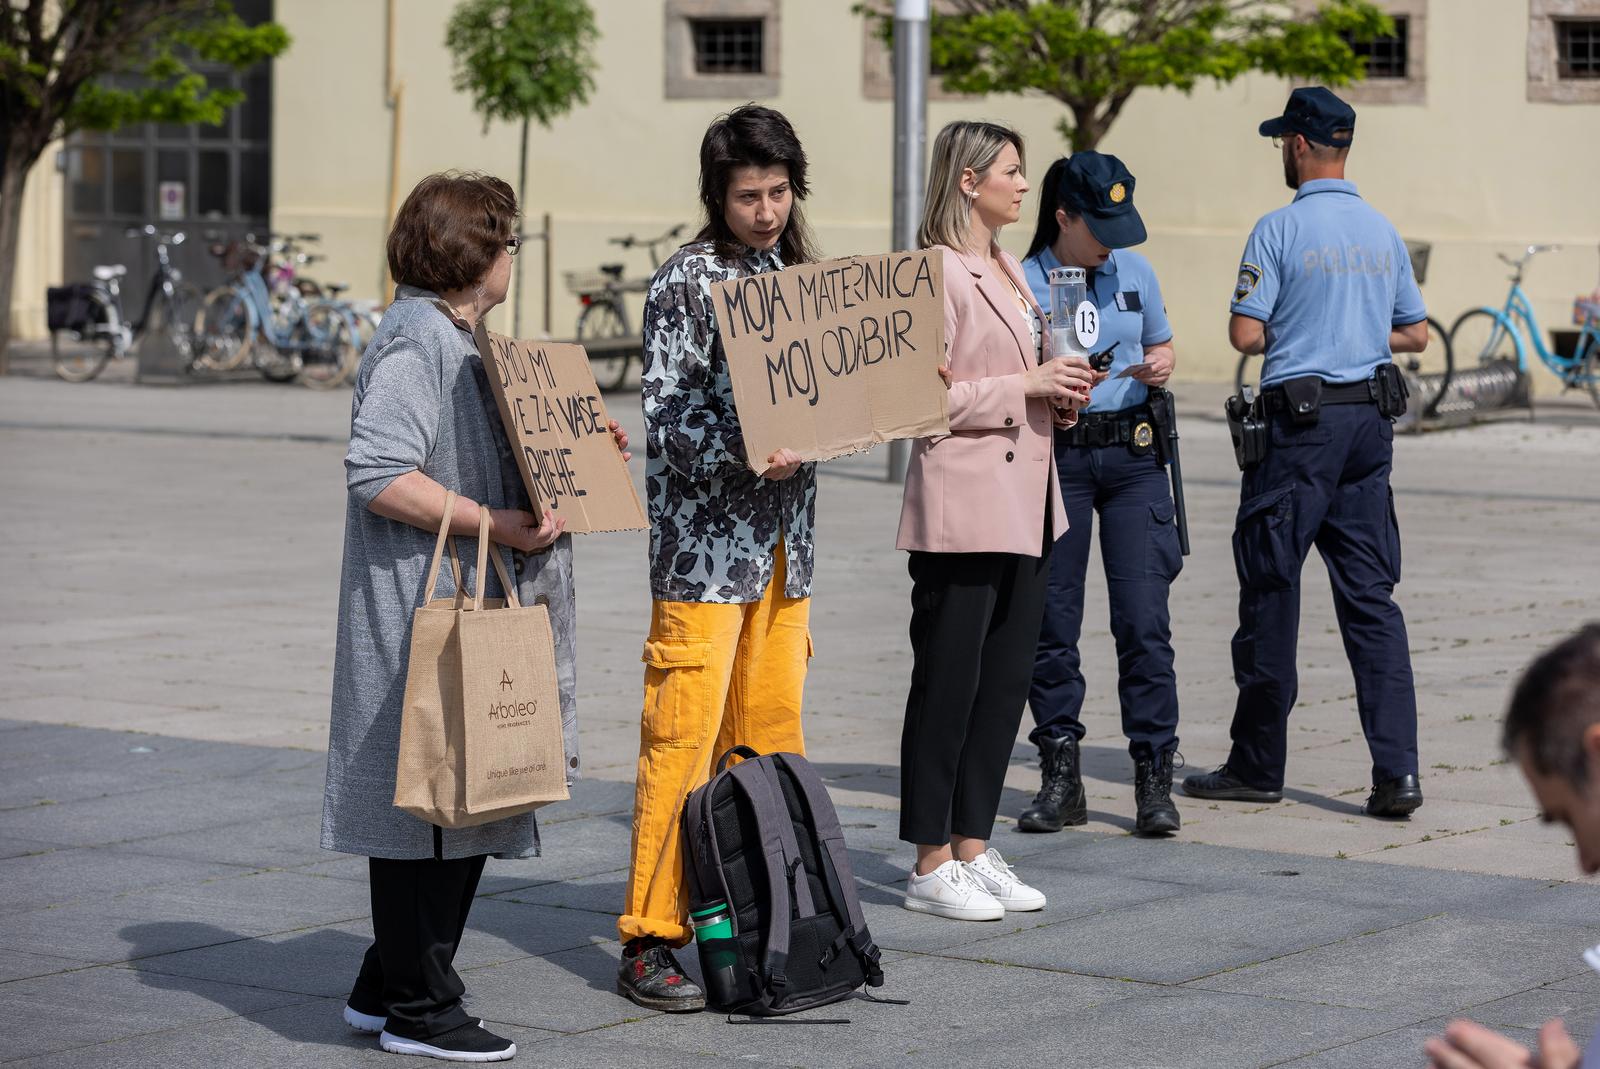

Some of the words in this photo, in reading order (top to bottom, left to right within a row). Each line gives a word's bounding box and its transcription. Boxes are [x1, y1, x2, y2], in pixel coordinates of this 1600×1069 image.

[722, 275, 792, 342] MOJA
[798, 256, 935, 324] MATERNICA
[1080, 310, 1096, 334] 13
[527, 347, 557, 390] MI
[765, 338, 819, 407] MOJ
[821, 309, 916, 377] ODABIR
[529, 394, 563, 434] ZA
[556, 390, 607, 440] VAŠE
[500, 669, 514, 691] A
[488, 700, 537, 720] Arboleo
